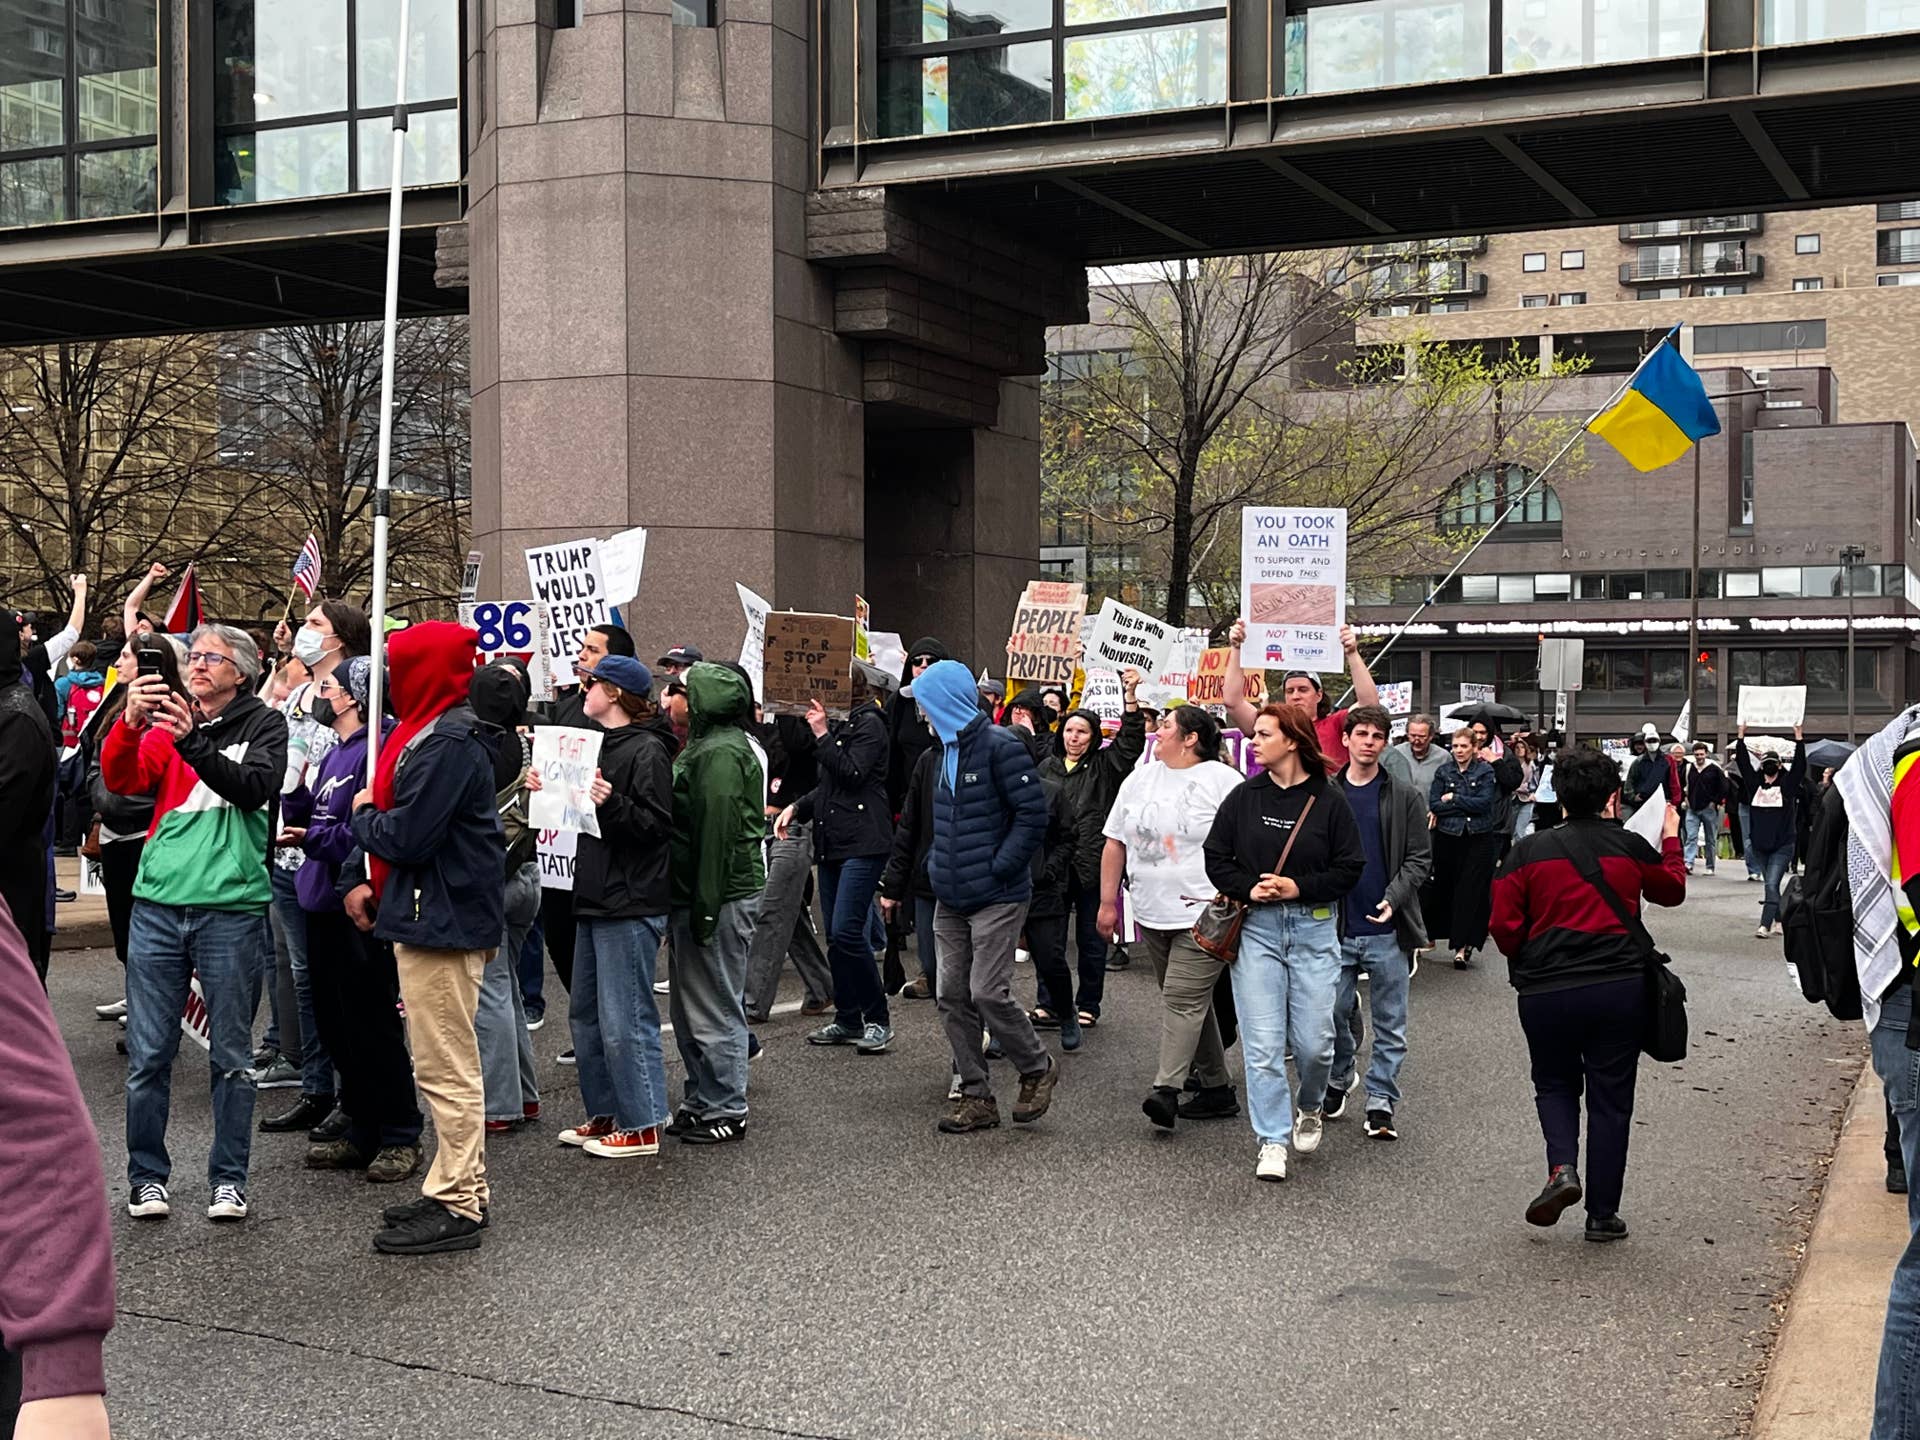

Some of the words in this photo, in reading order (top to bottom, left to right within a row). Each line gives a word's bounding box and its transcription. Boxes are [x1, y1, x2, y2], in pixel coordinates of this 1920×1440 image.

[1255, 516, 1286, 529] YOU
[1294, 516, 1335, 529] TOOK
[1257, 534, 1279, 548] AN
[1288, 533, 1329, 547] OATH
[1561, 547, 1679, 559] American
[1701, 543, 1784, 556] Public
[529, 547, 592, 577] TRUMP
[1254, 556, 1265, 564] TO
[1268, 556, 1305, 565] SUPPORT
[1311, 558, 1331, 566] AND
[1261, 570, 1293, 578] DEFEND
[536, 573, 597, 603] WOULD
[546, 598, 606, 630] EPORT
[1016, 608, 1080, 634] PEOPLE
[473, 602, 532, 652] 86
[1112, 608, 1133, 629] This
[1133, 618, 1144, 630] is
[1144, 620, 1165, 640] who
[1113, 631, 1128, 645] we
[1266, 630, 1288, 639] NOT
[1026, 636, 1050, 653] OVER
[784, 650, 827, 665] STOP
[1099, 642, 1154, 673] INDIVISIBLE
[1201, 651, 1221, 671] NO
[1008, 653, 1074, 681] PROFITS
[810, 677, 839, 690] LYING
[1104, 685, 1119, 696] ON
